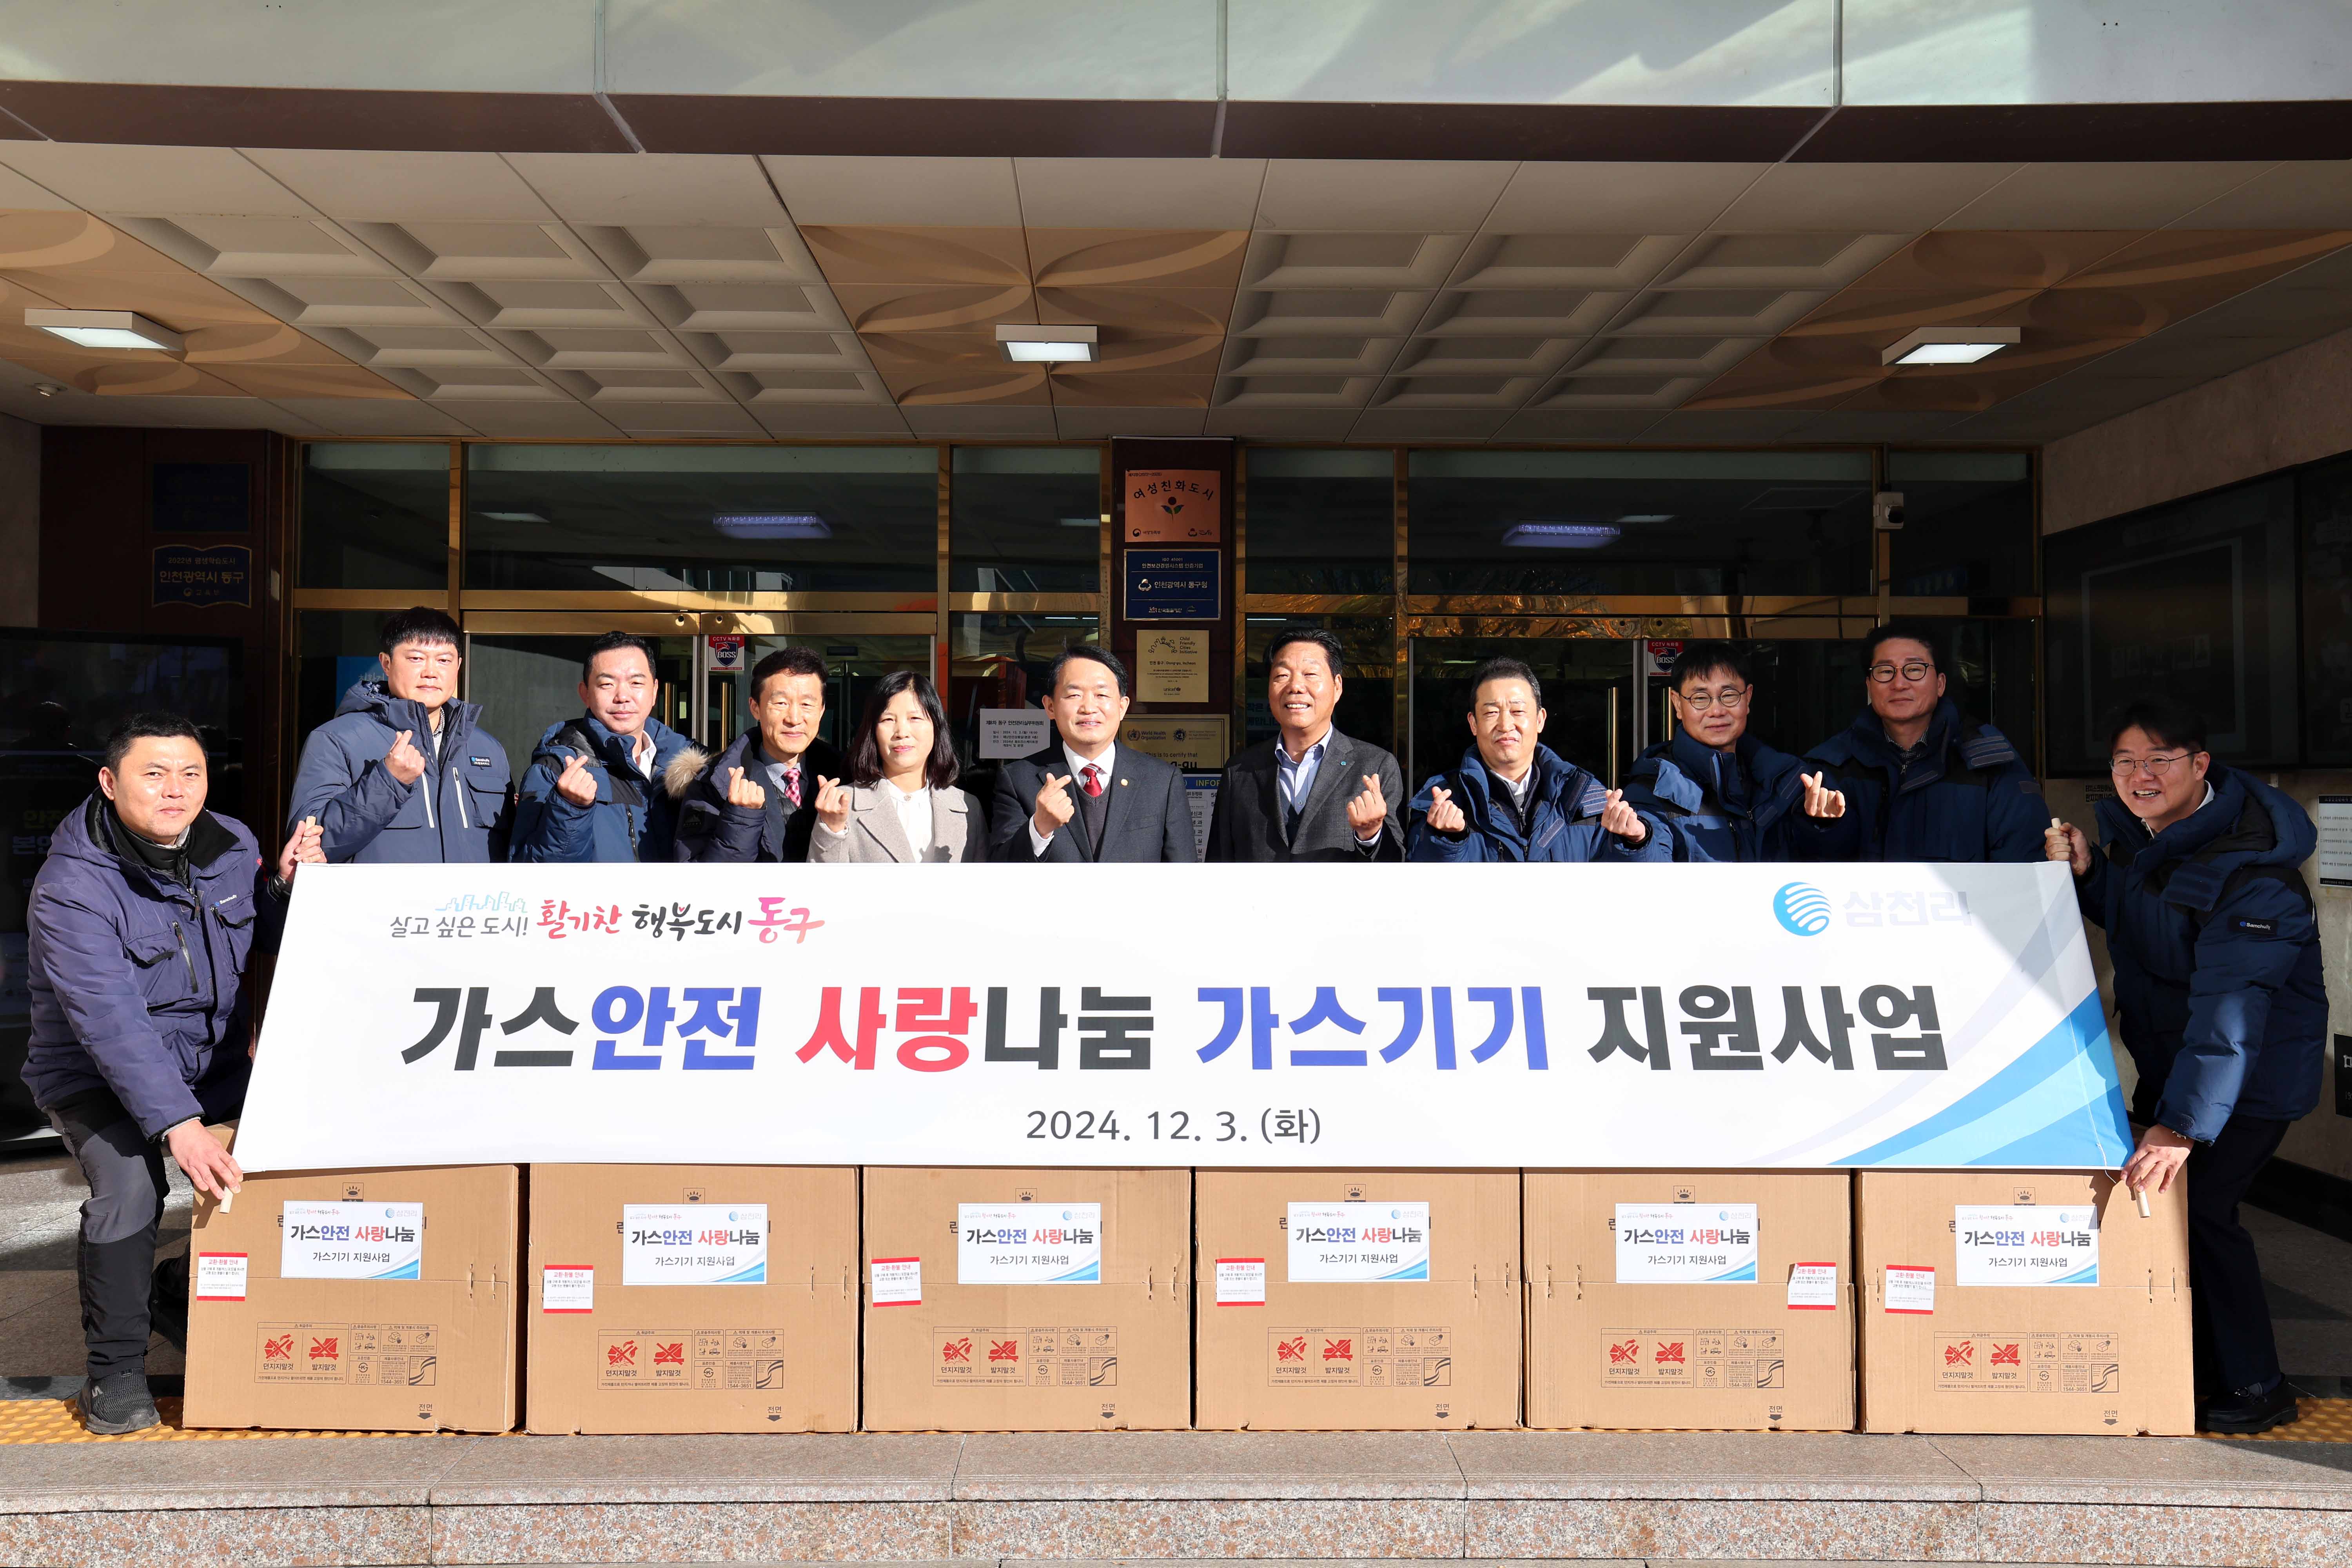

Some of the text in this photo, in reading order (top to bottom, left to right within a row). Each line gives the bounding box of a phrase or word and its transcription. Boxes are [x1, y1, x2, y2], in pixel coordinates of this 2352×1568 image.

[1134, 480, 1214, 501] 여성친화도시
[160, 571, 244, 583] 인천광역시 동구
[1843, 891, 1972, 927] 삼천리
[390, 897, 824, 943] 살고 싶은 도시! 활기찬 행복도시 동구
[401, 985, 1948, 1072] 가스안전 사랑나눔 가스기기 지원사업
[1027, 1108, 1320, 1144] 2024. 12. 3. (화)
[291, 1225, 415, 1243] 가스안전 사랑나눔
[632, 1230, 760, 1245] 가스안전 사랑나눔
[967, 1229, 1093, 1244] 가스안전 사랑나눔
[1296, 1227, 1422, 1243] 가스안전 사랑나눔
[1624, 1229, 1750, 1245] 가스안전 사랑나눔
[1964, 1230, 2091, 1247] 가스안전 사랑나눔
[313, 1252, 390, 1262] 가스기기 지원사업
[655, 1257, 735, 1266] 가스기기 지원사업
[990, 1256, 1069, 1265] 가스기기 지원사업
[1320, 1254, 1398, 1263] 가스기기 지원사업
[1648, 1255, 1726, 1265] 가스기기 지원사업
[1989, 1258, 2067, 1267] 가스기기 지원사업
